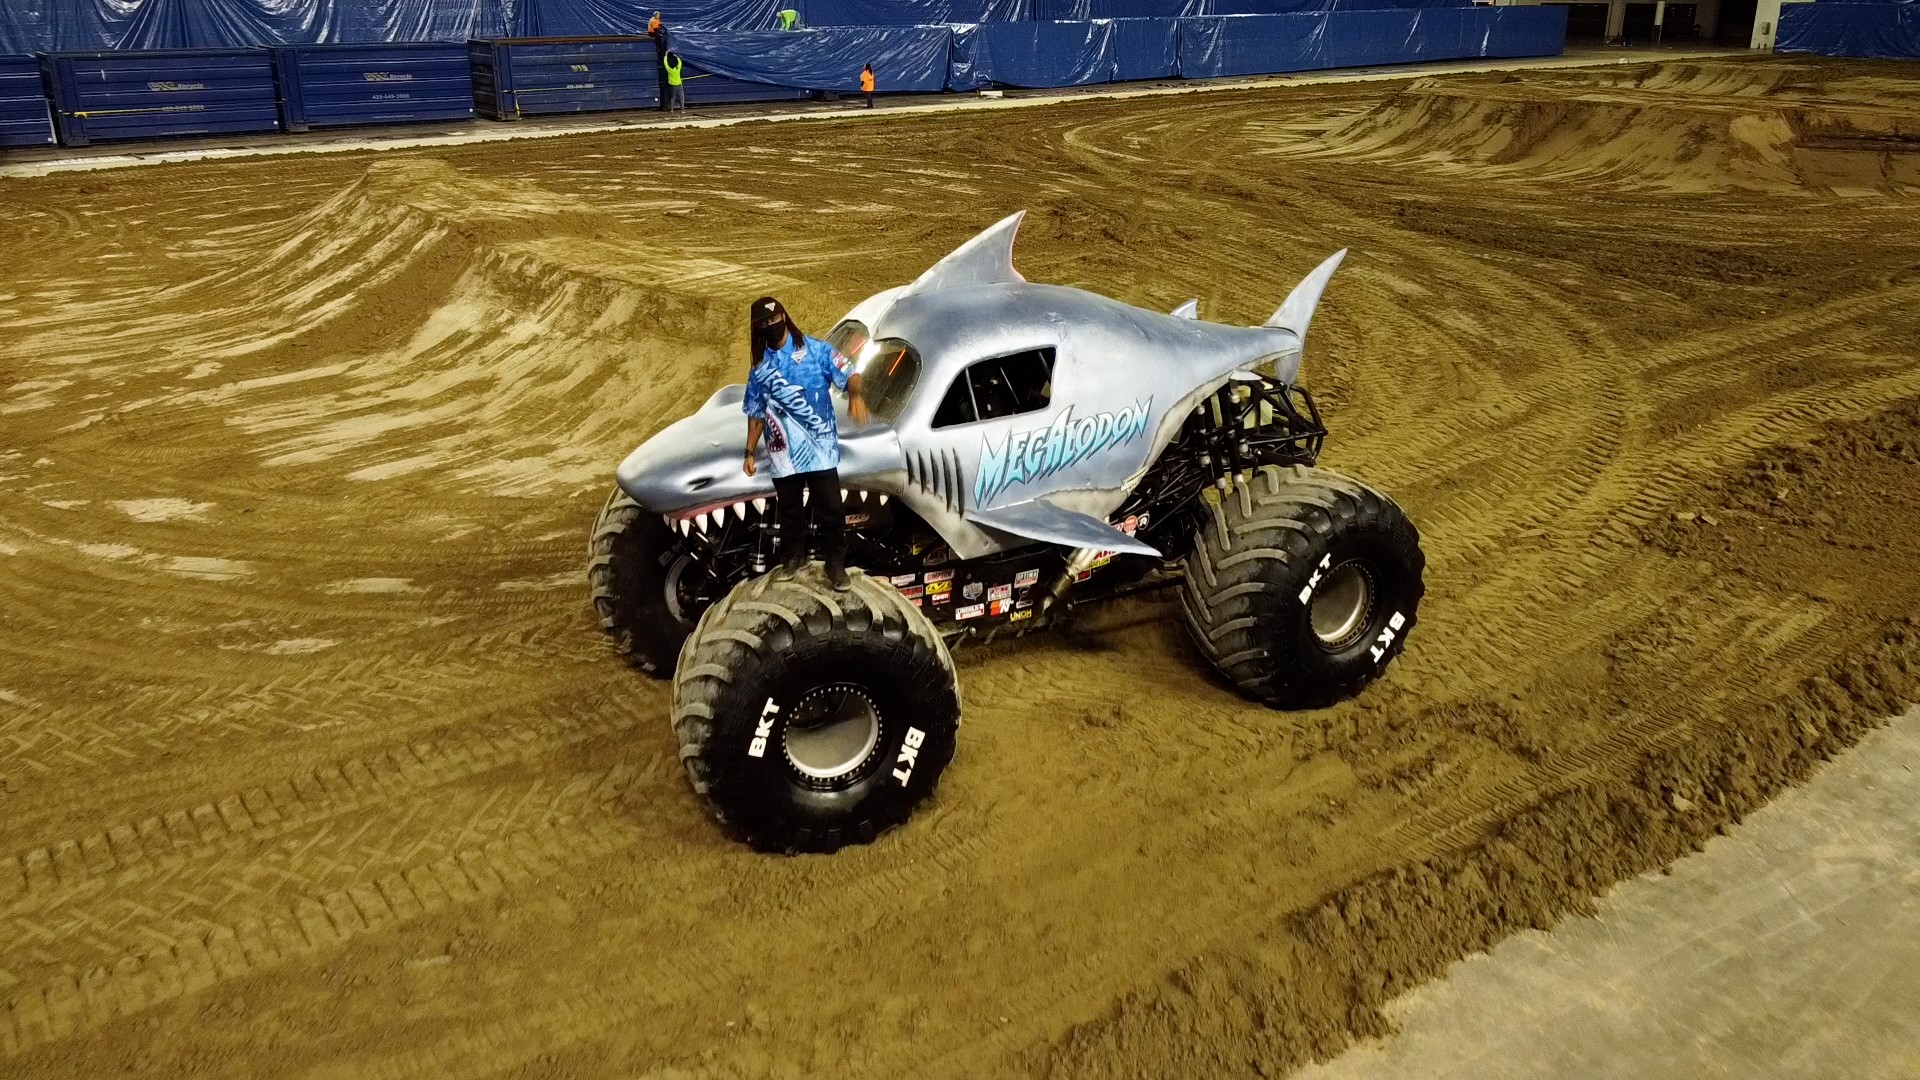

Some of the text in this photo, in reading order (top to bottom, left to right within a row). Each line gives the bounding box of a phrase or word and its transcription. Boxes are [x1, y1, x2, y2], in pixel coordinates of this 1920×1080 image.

[754, 360, 832, 436] MEGALODON
[974, 394, 1154, 509] MEGALODON
[1298, 553, 1331, 605] BKT
[1010, 609, 1032, 622] UNOH
[1369, 611, 1406, 664] BKT
[747, 697, 780, 758] BKT
[891, 726, 926, 788] BKT
